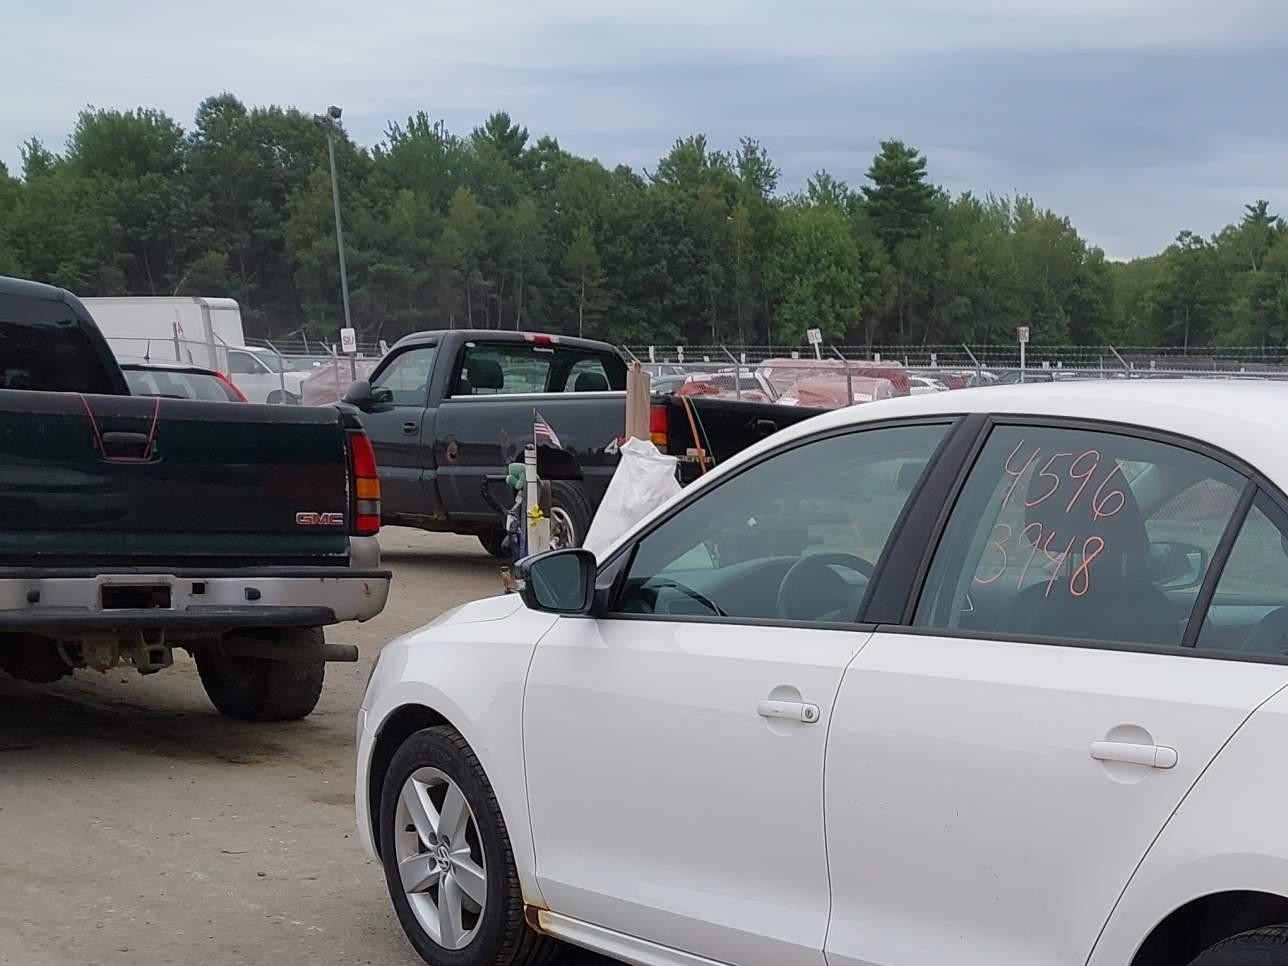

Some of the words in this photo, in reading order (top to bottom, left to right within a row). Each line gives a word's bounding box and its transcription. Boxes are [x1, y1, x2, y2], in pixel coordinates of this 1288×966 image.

[295, 511, 344, 525] GMC
[1005, 439, 1125, 521] 4596
[974, 521, 1105, 598] 3948
